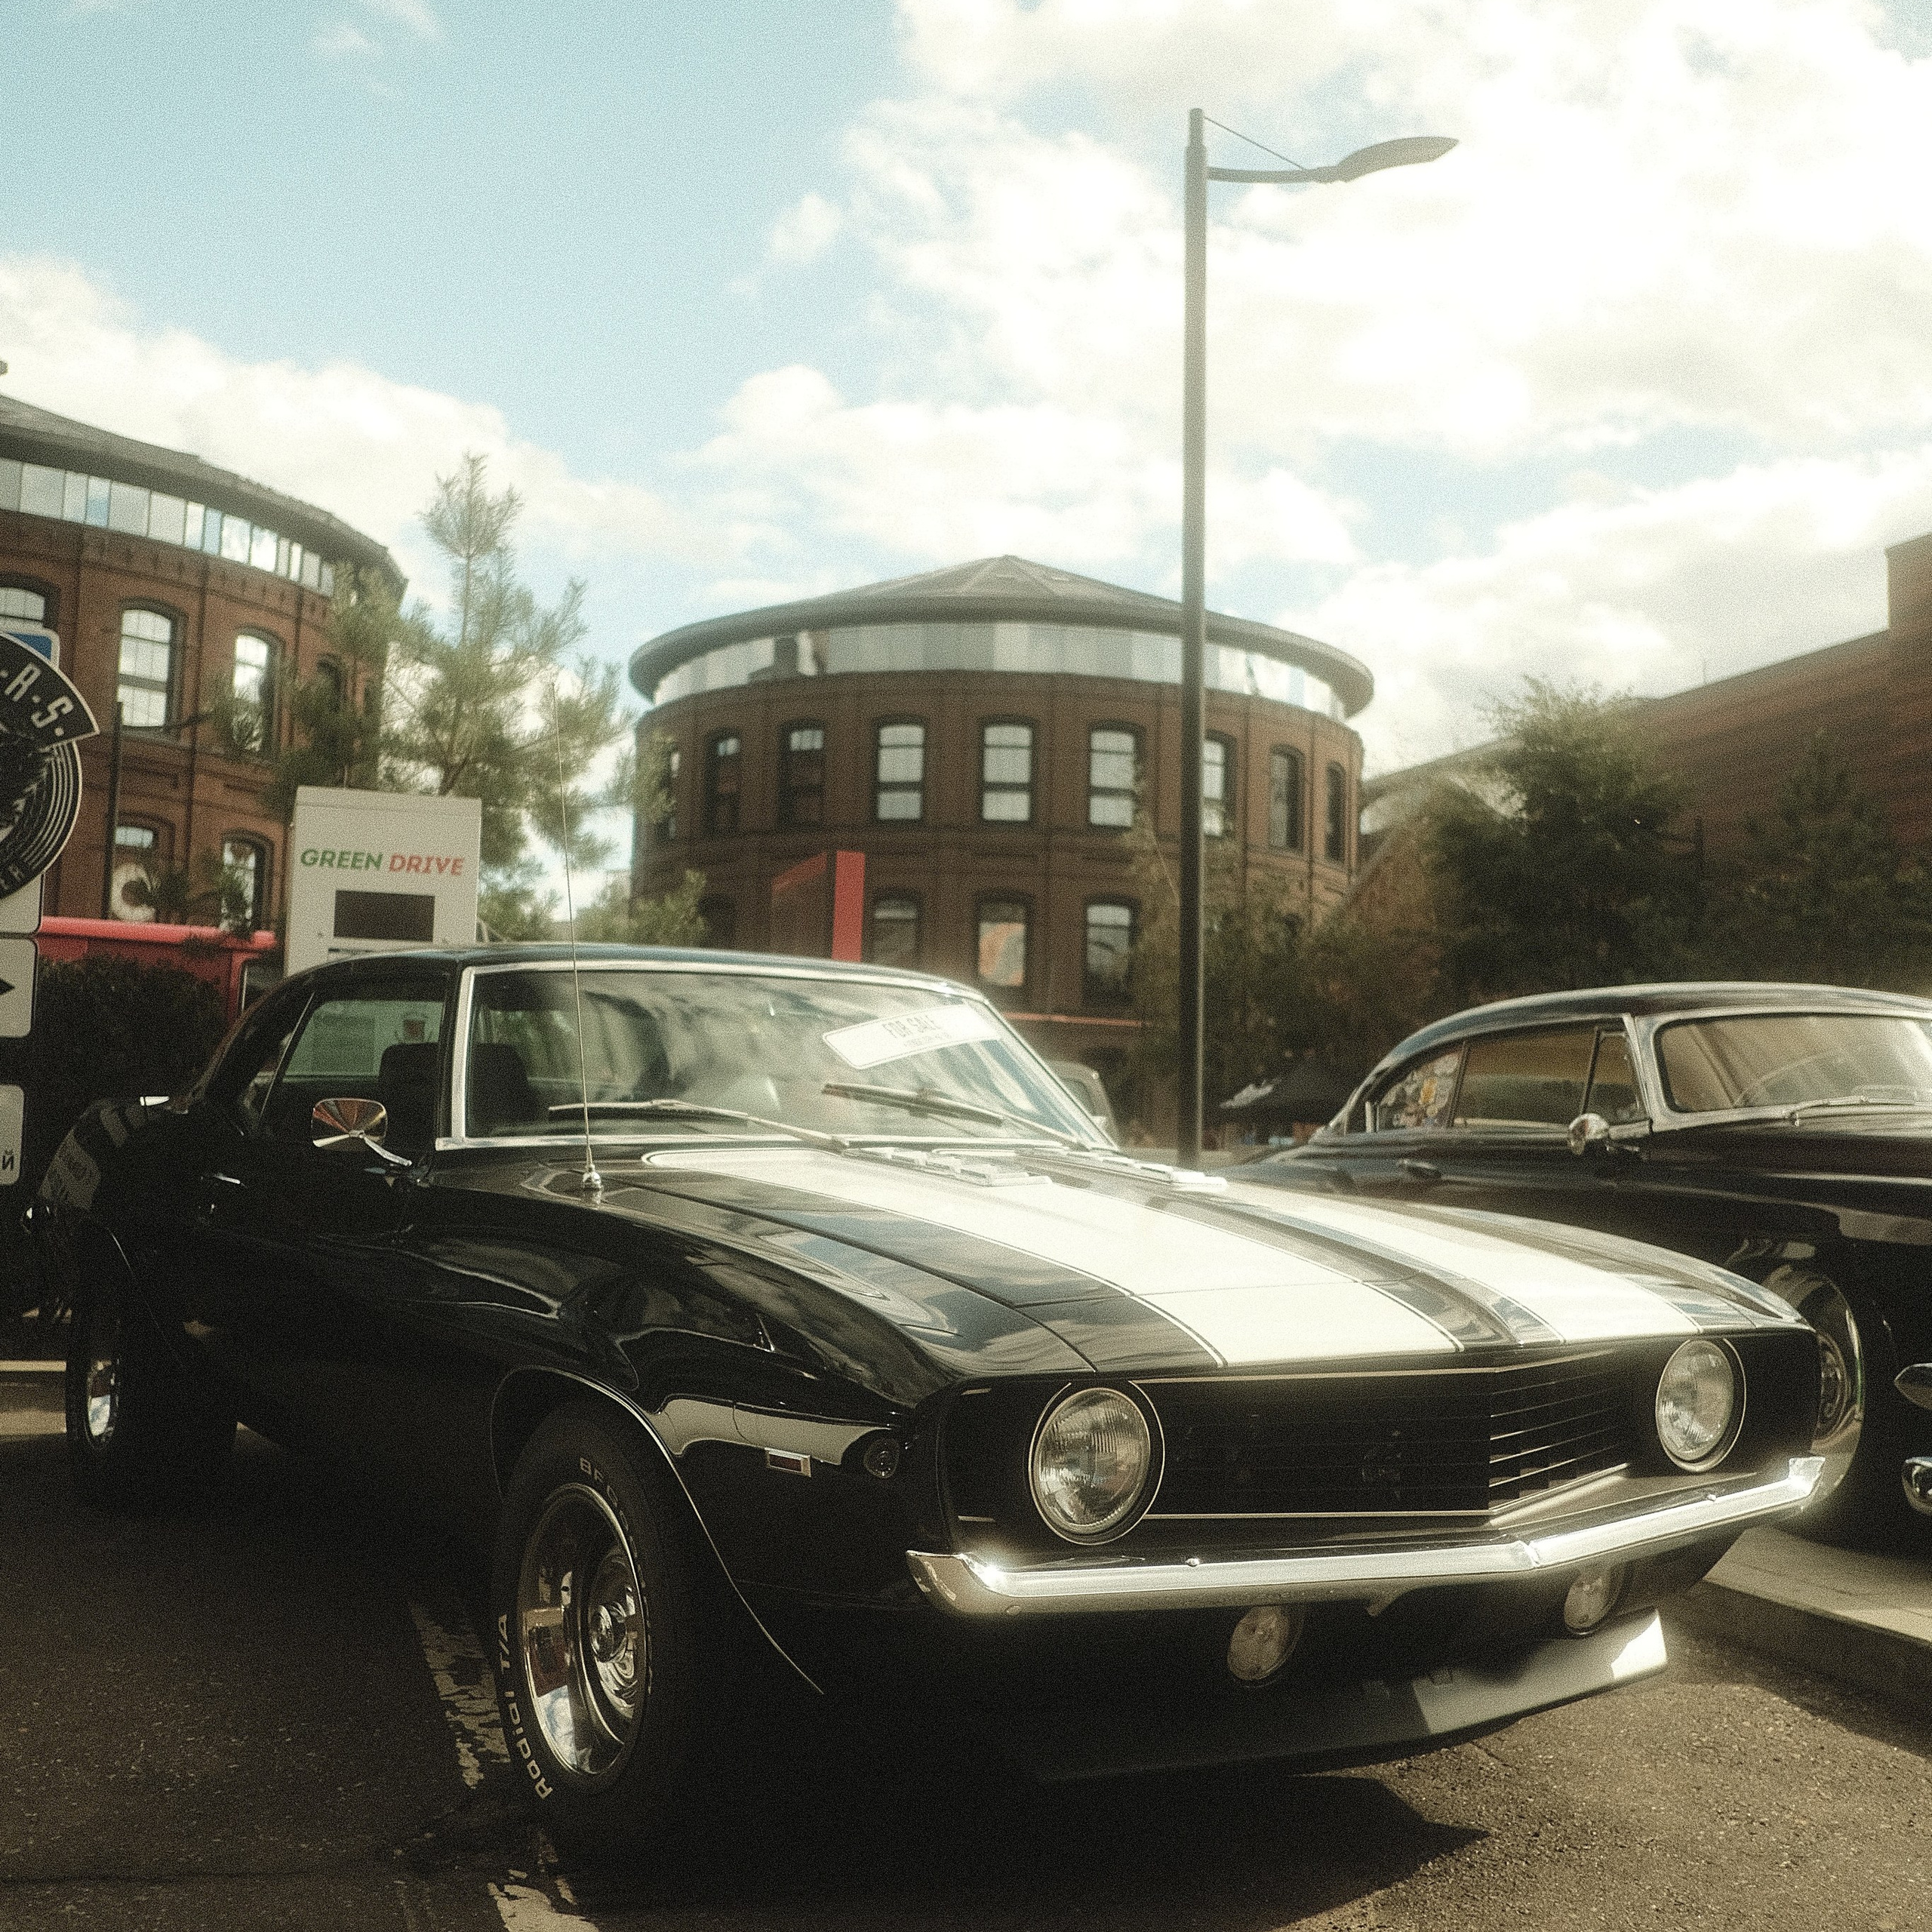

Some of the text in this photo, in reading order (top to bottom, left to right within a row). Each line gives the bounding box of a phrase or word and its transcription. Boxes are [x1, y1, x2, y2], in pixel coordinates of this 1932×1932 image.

[300, 848, 465, 875] GREEN DRIVE
[881, 1015, 942, 1038] FOR SALE
[497, 1614, 554, 1801] Radial T/A
